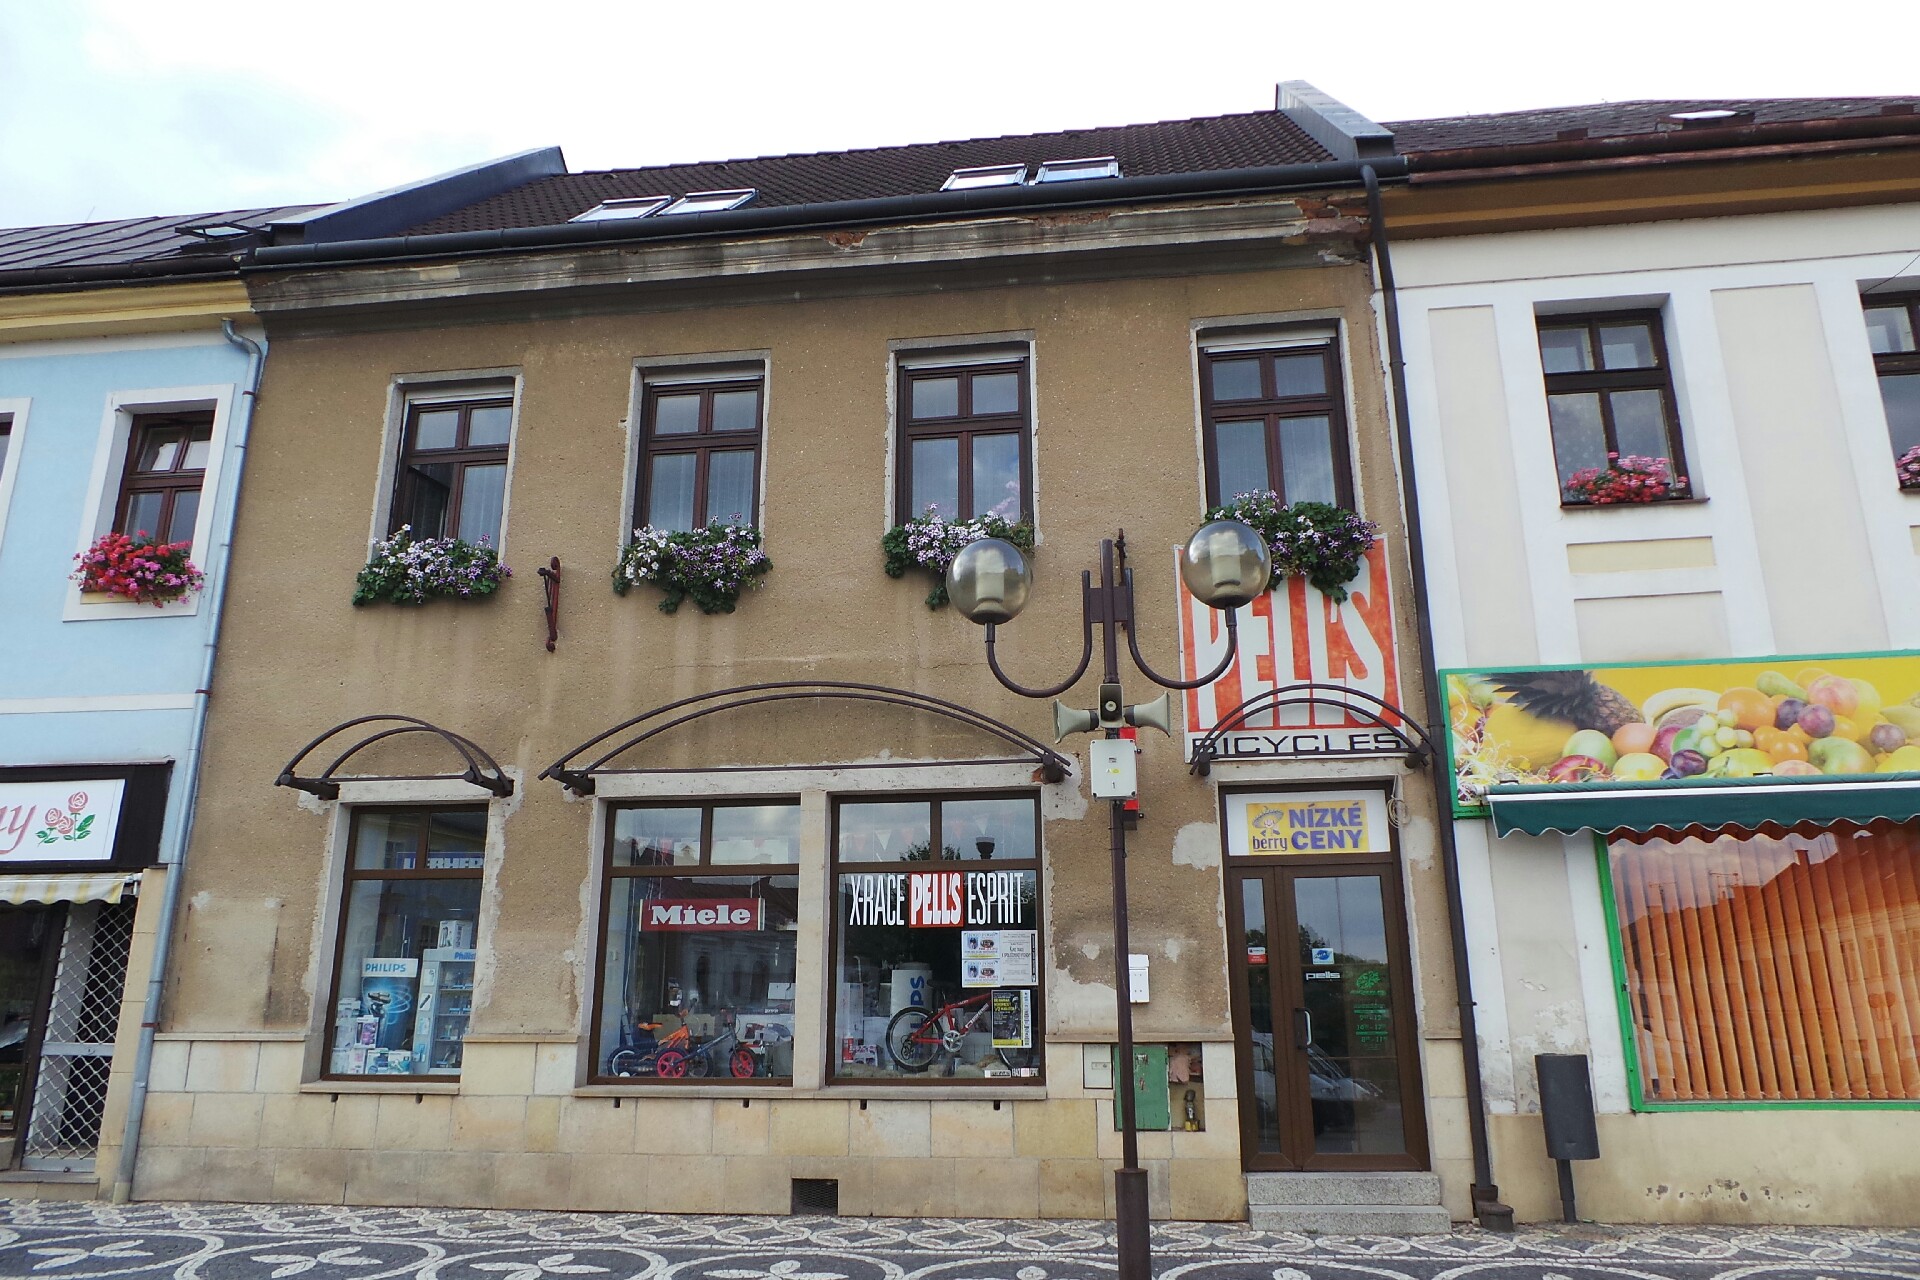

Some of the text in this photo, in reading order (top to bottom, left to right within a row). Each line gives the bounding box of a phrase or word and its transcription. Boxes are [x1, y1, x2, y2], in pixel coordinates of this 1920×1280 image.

[1191, 732, 1401, 756] BICYCLES
[1288, 802, 1363, 828] NÍZKÉ
[1252, 835, 1288, 851] berry
[1291, 829, 1363, 850] CENY
[849, 874, 905, 926] X-RACE
[967, 872, 1024, 925] ESPRIT
[650, 904, 751, 925] Miele
[365, 963, 407, 972] PHILIPS
